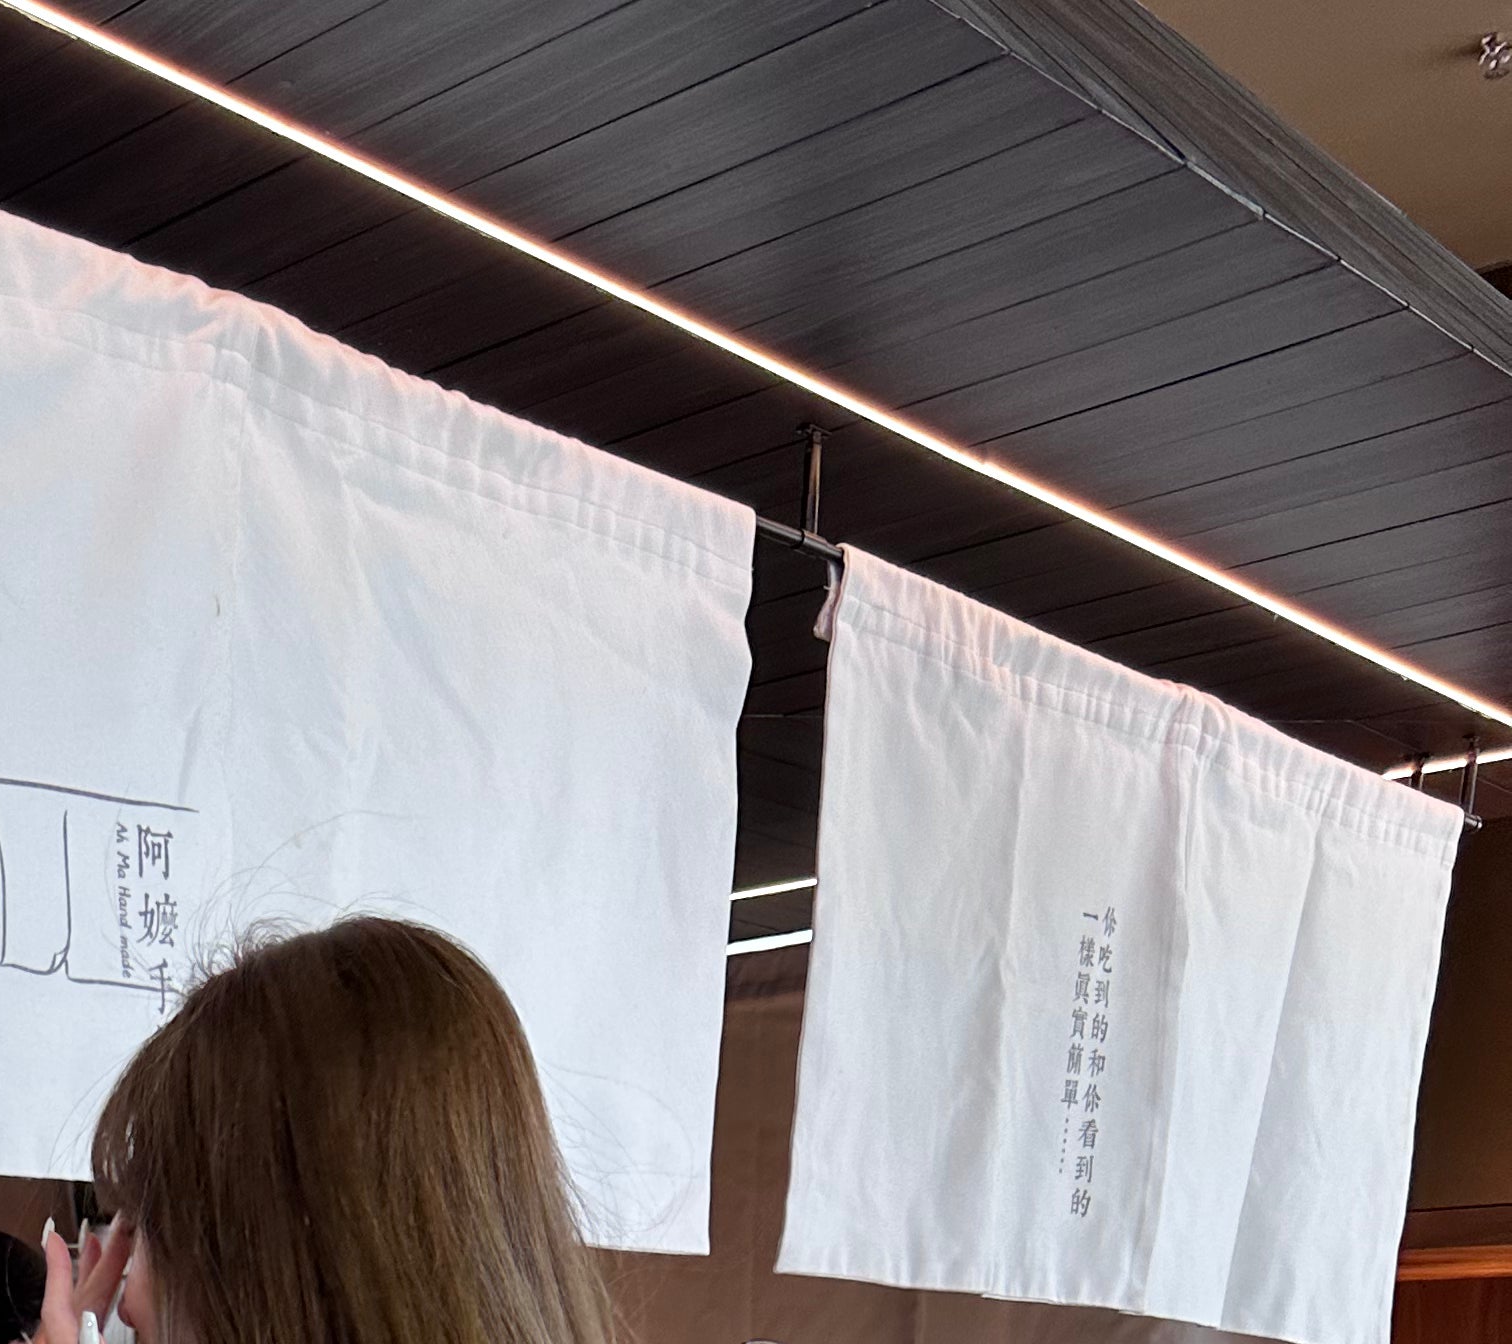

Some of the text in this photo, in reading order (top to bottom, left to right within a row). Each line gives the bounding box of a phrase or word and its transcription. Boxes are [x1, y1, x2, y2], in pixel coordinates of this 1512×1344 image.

[115, 821, 135, 980] Ah Ma Hand made
